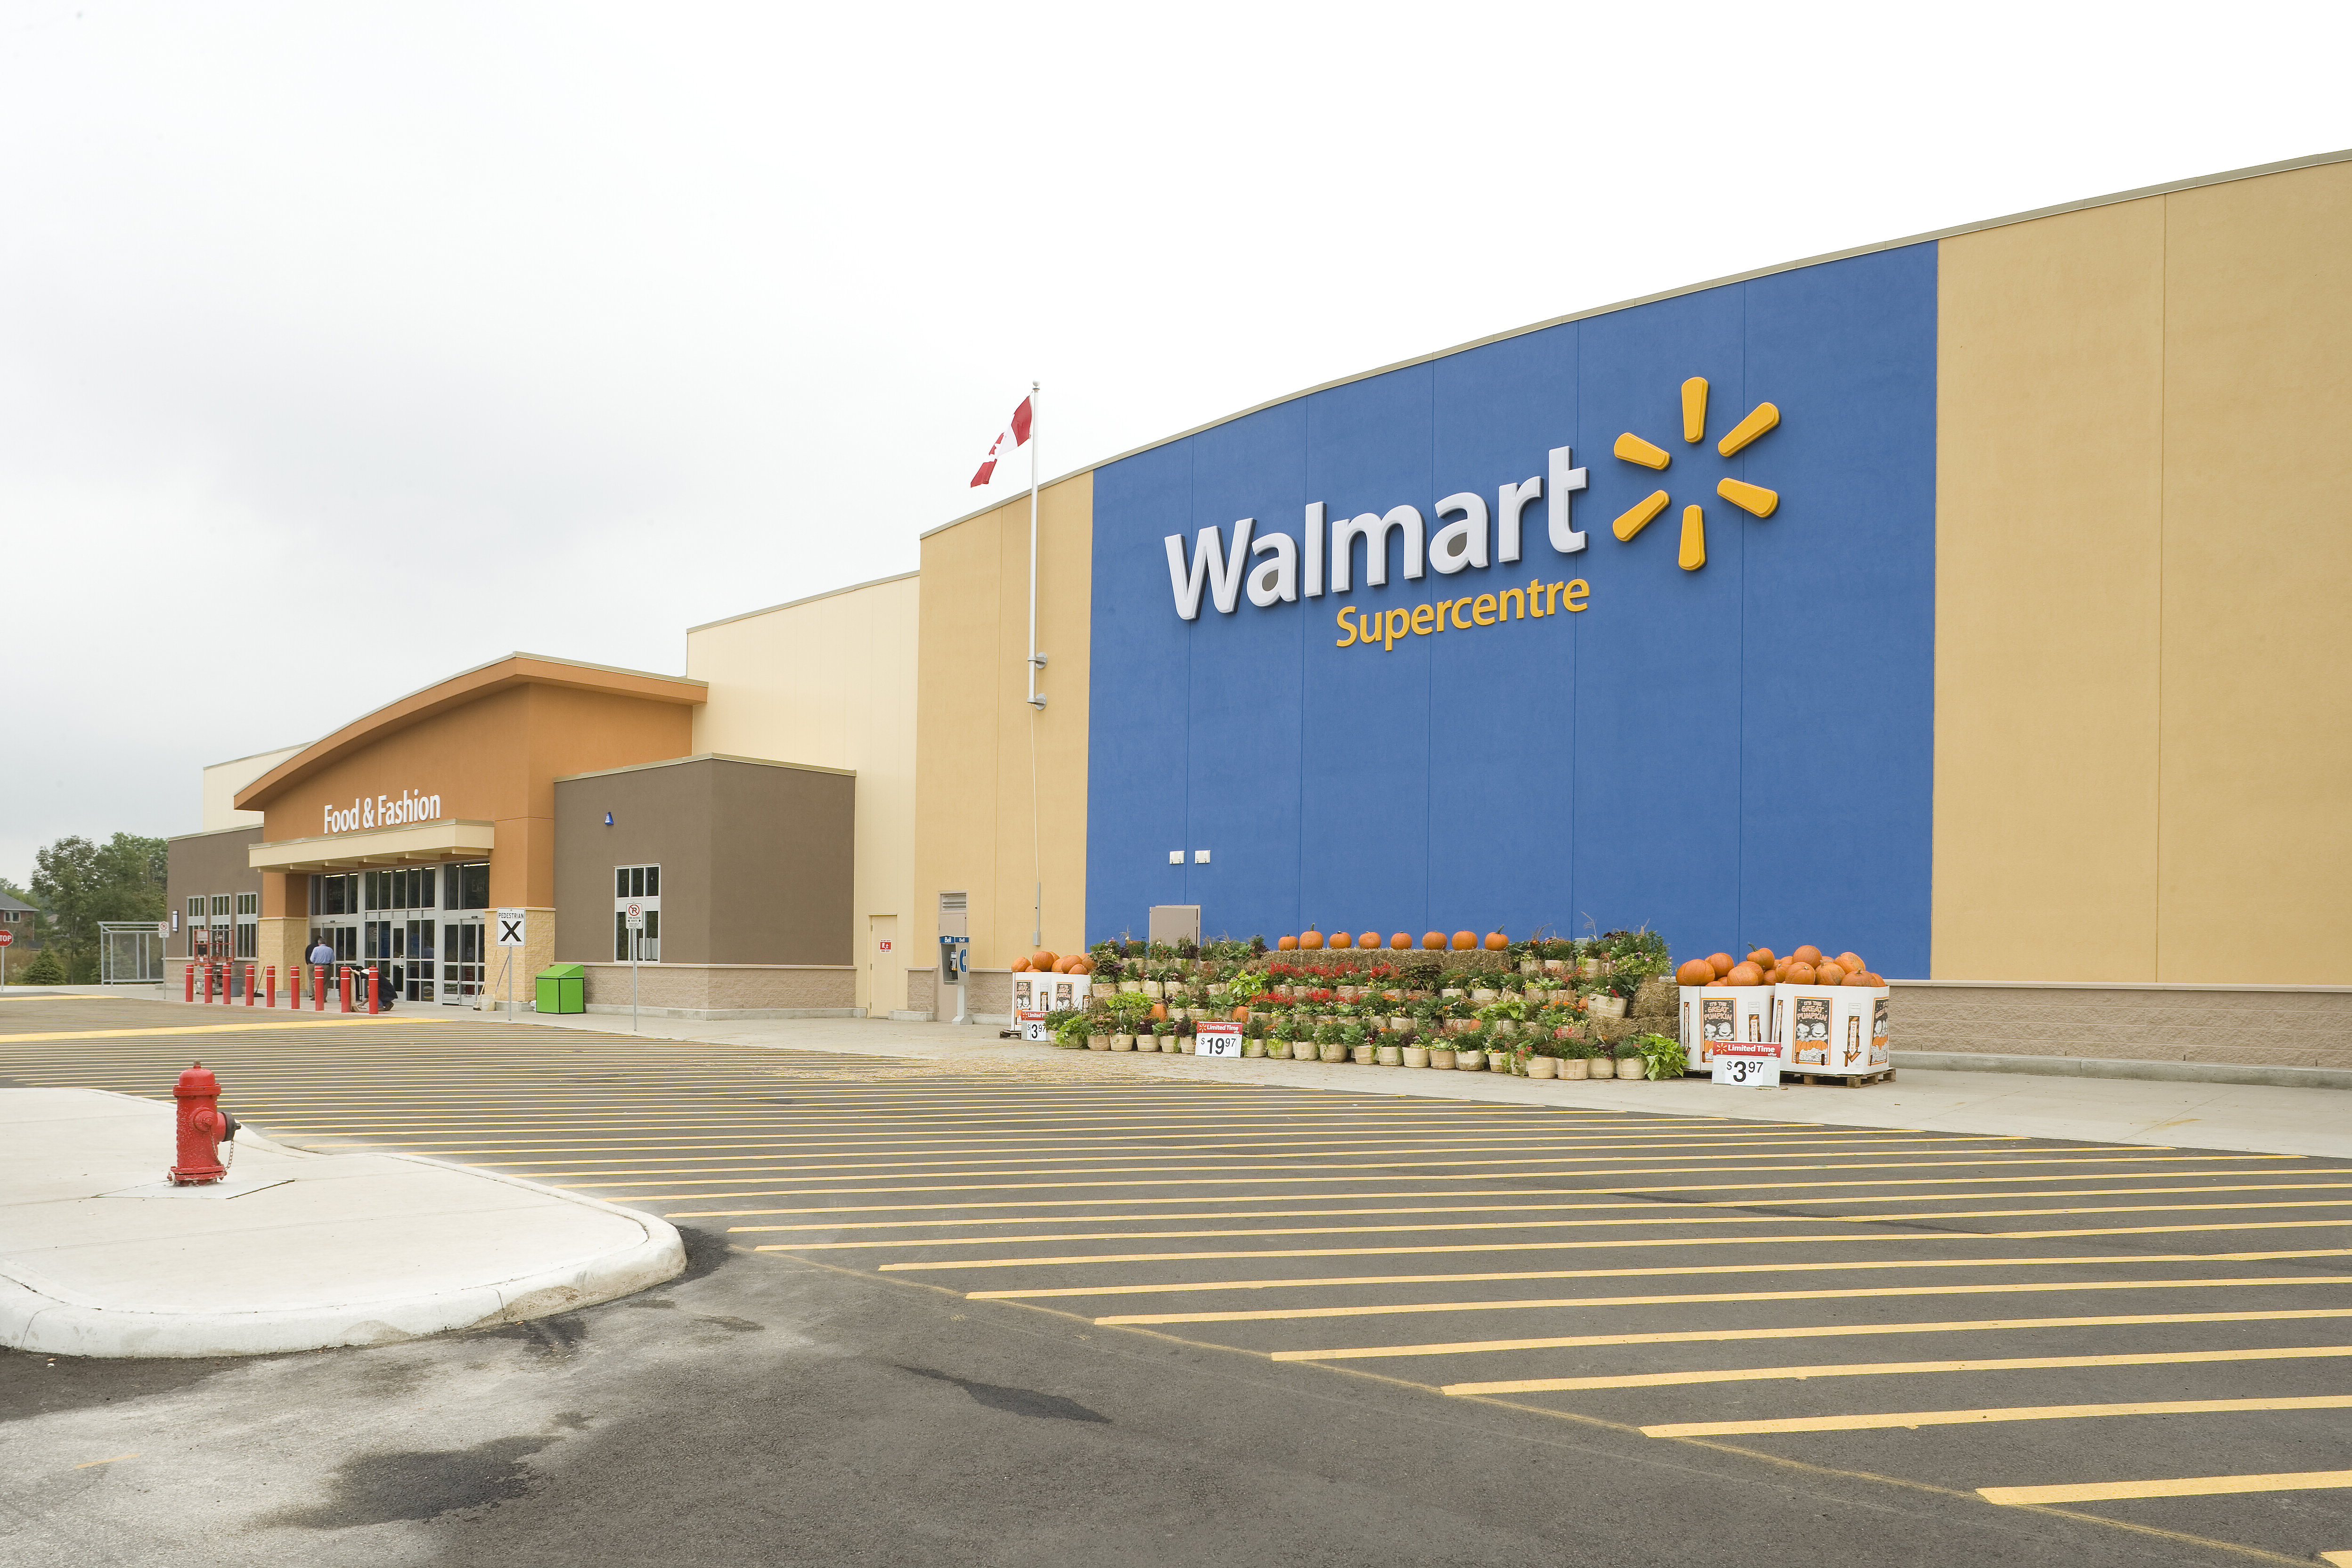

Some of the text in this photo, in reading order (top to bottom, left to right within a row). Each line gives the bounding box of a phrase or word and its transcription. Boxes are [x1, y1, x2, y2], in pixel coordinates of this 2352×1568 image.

[1164, 446, 1588, 621] Walmart
[1336, 578, 1590, 651] Supercentre
[324, 789, 441, 833] Food & Fashion
[500, 921, 522, 941] X
[1797, 1013, 1828, 1021] PUMPKIN
